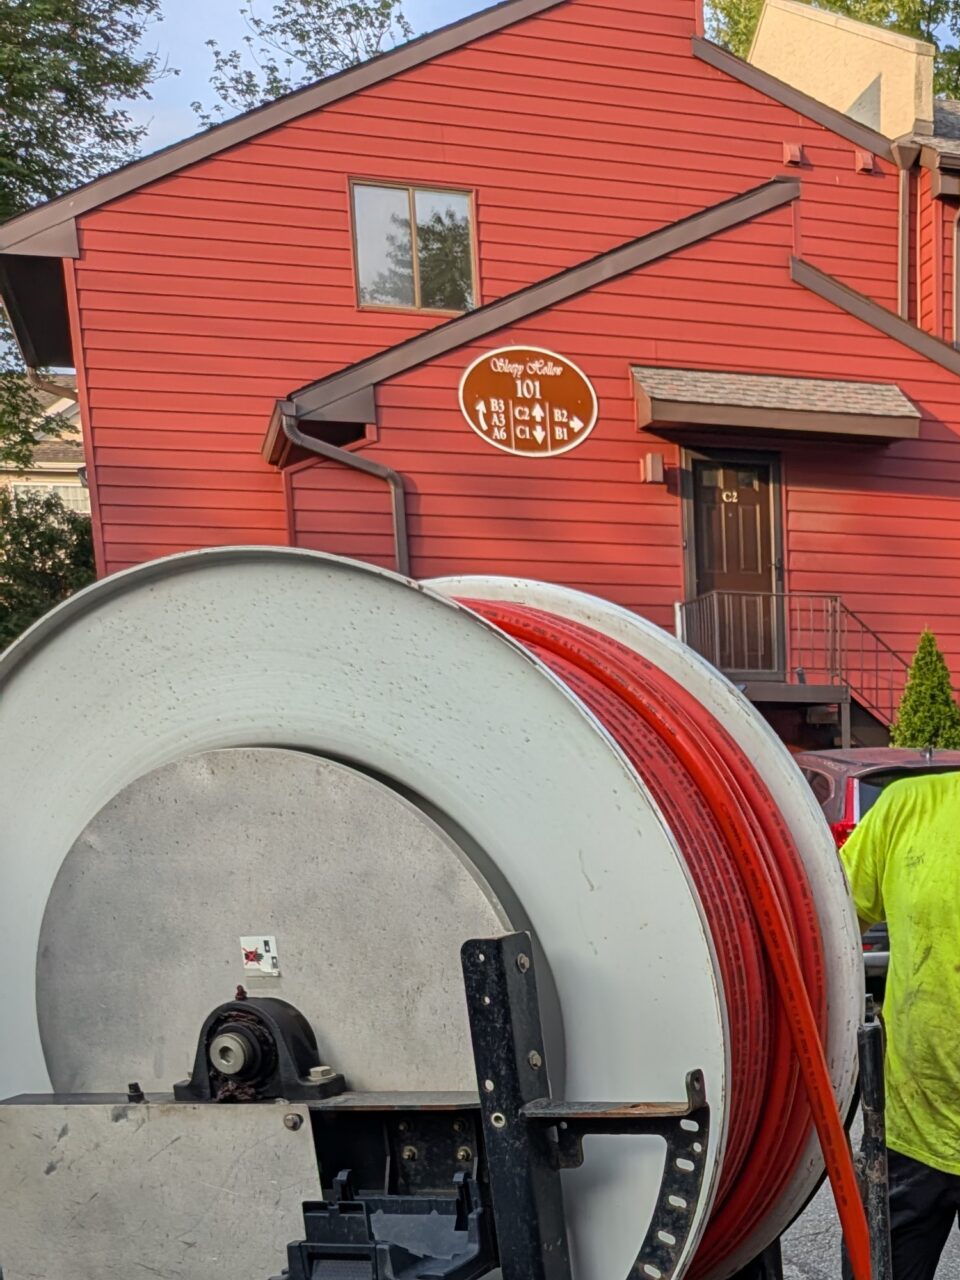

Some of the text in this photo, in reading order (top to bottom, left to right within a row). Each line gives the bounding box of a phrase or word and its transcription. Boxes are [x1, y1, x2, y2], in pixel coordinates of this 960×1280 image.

[490, 357, 563, 378] Sleepy Hollow
[515, 379, 542, 399] 101
[490, 398, 505, 412] B3
[491, 413, 506, 427] A3
[514, 406, 530, 420] C2
[553, 408, 568, 422] B2
[492, 427, 507, 440] A6
[516, 426, 530, 439] C1
[555, 427, 568, 440] B1
[722, 491, 738, 503] C2
